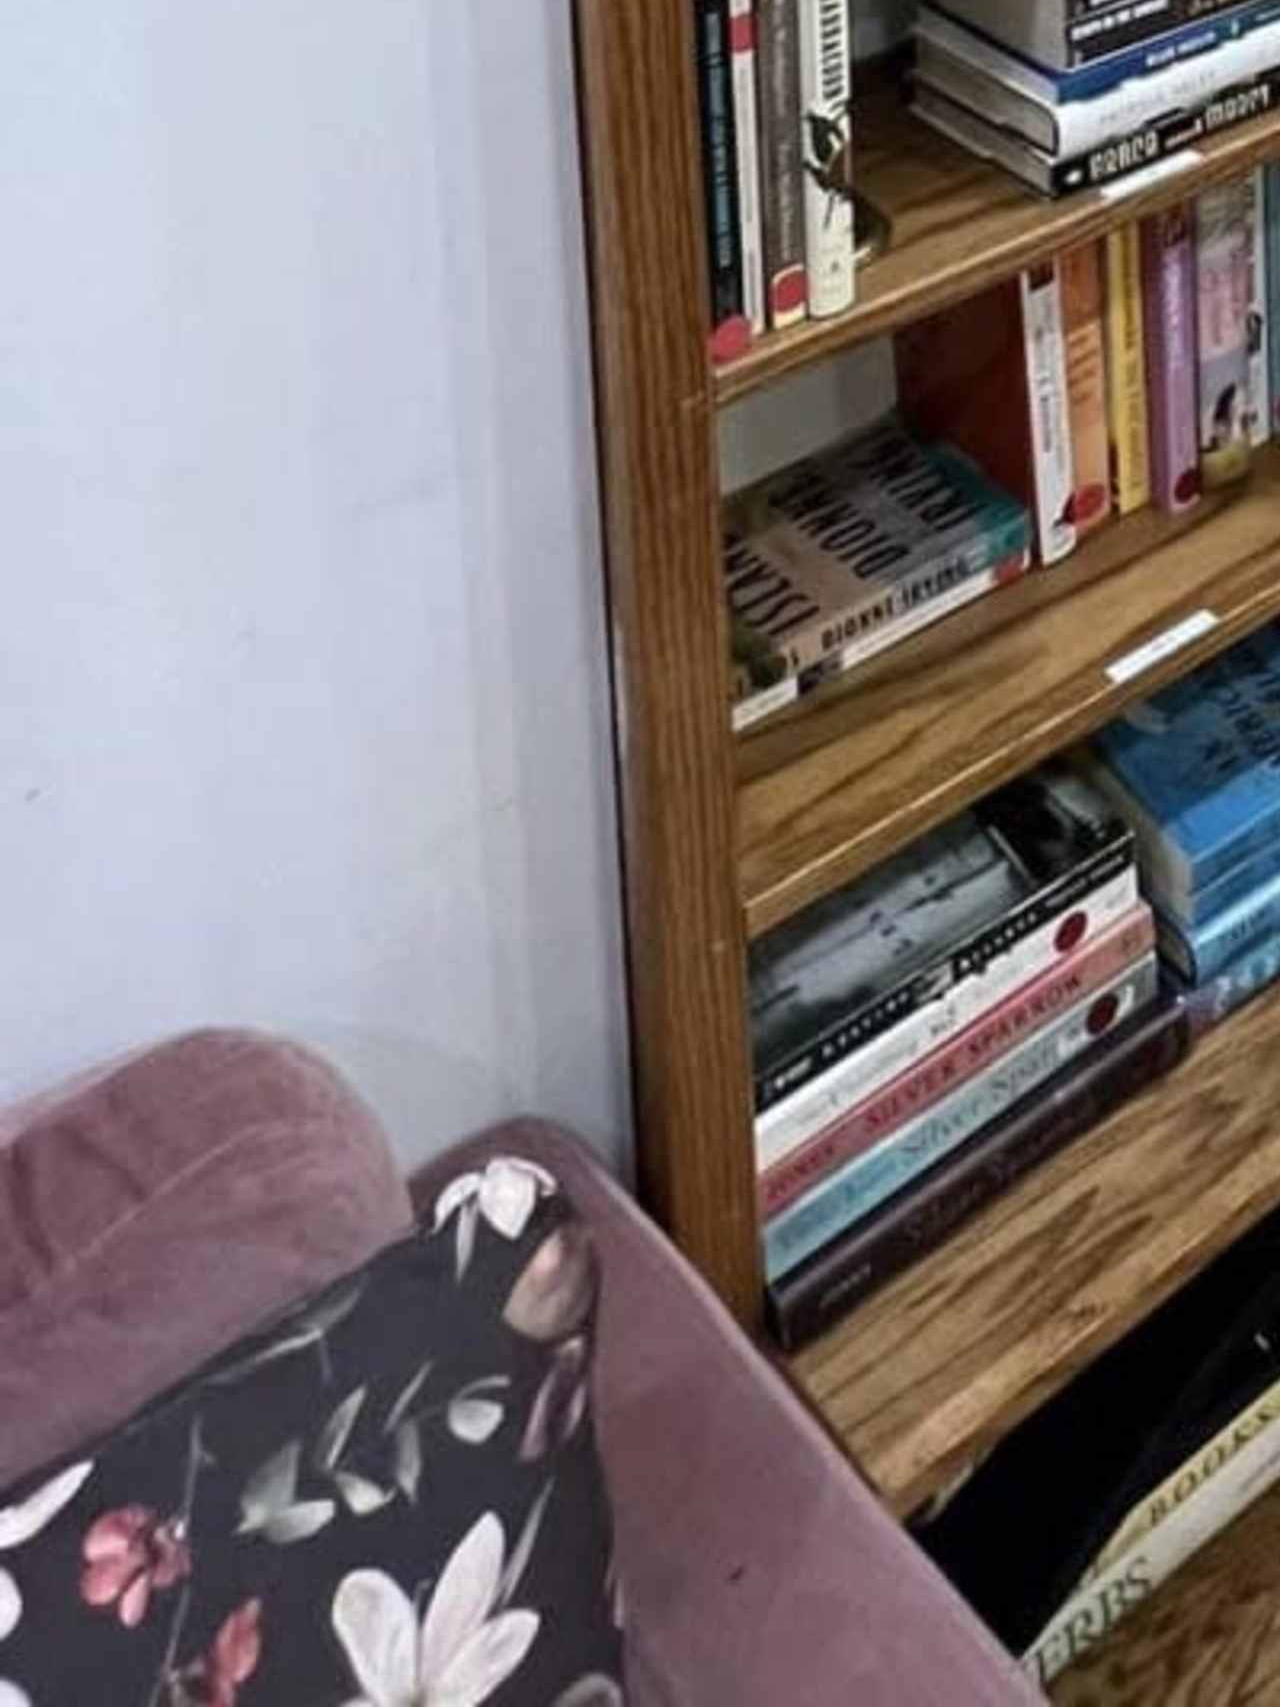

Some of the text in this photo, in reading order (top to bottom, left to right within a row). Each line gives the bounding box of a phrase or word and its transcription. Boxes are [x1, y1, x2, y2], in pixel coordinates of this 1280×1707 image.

[820, 595, 895, 651] DIONNE
[865, 973, 1083, 1129] SILVER SPARROW
